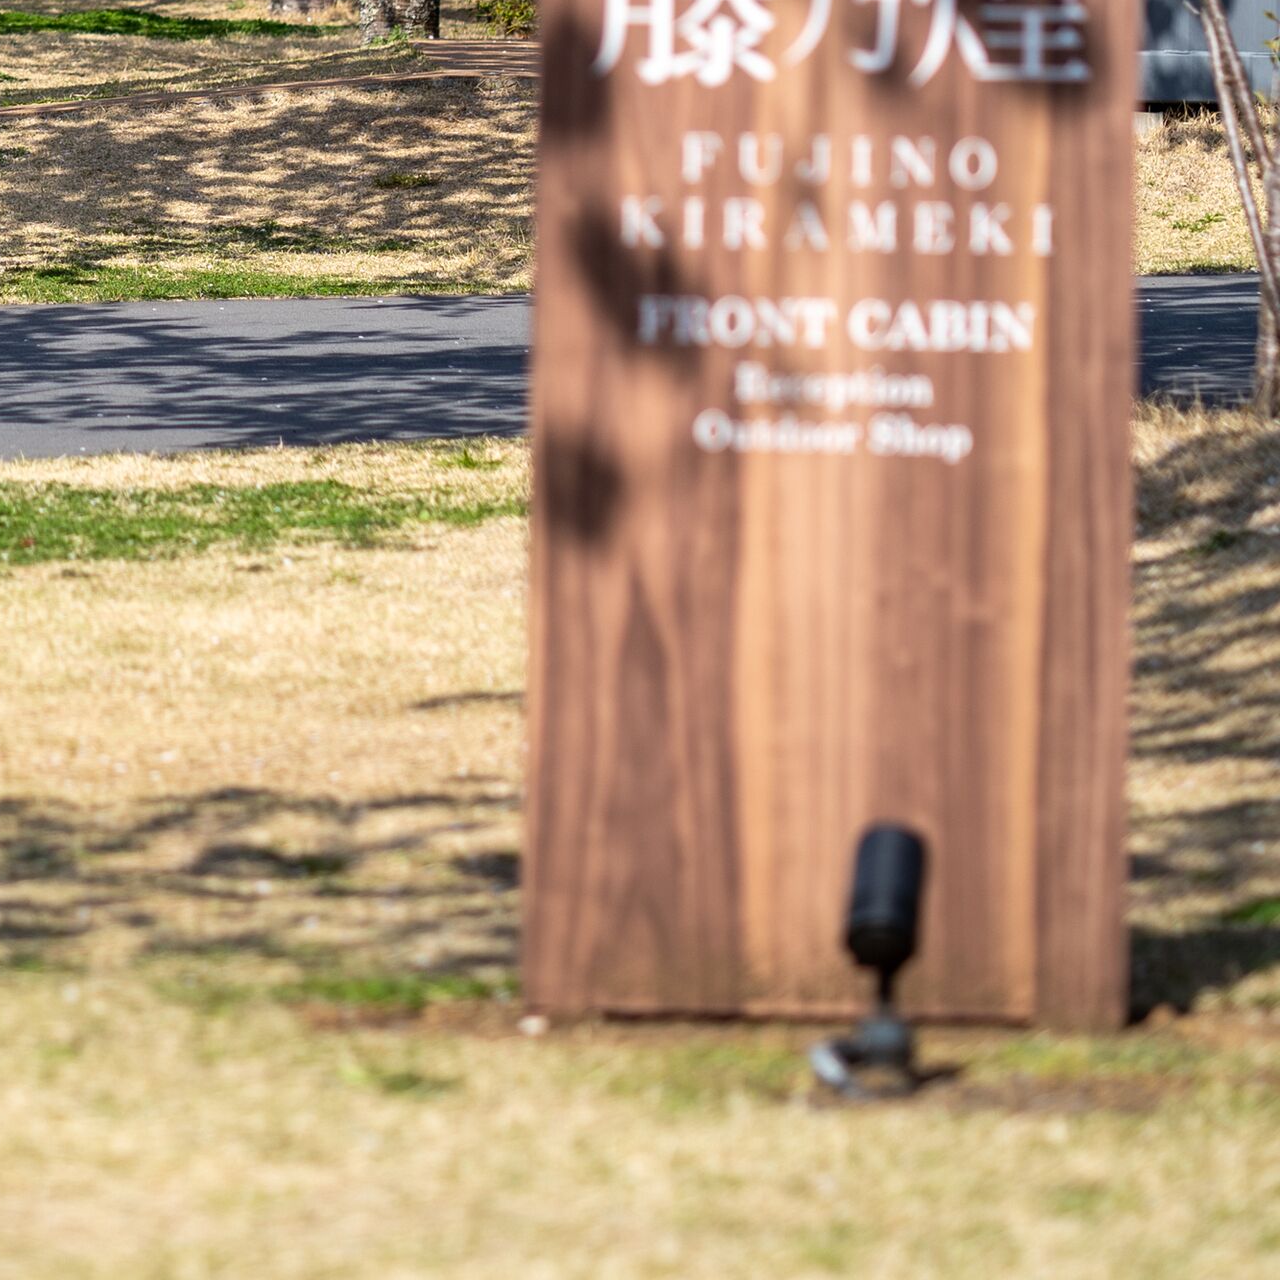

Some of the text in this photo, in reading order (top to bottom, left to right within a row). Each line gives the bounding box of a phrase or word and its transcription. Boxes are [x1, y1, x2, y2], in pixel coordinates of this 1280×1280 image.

[680, 130, 999, 190] FUJINO
[620, 194, 1055, 257] KIRAMEKI
[639, 295, 1035, 354] FRONT CABIN
[866, 411, 974, 465] Shop
